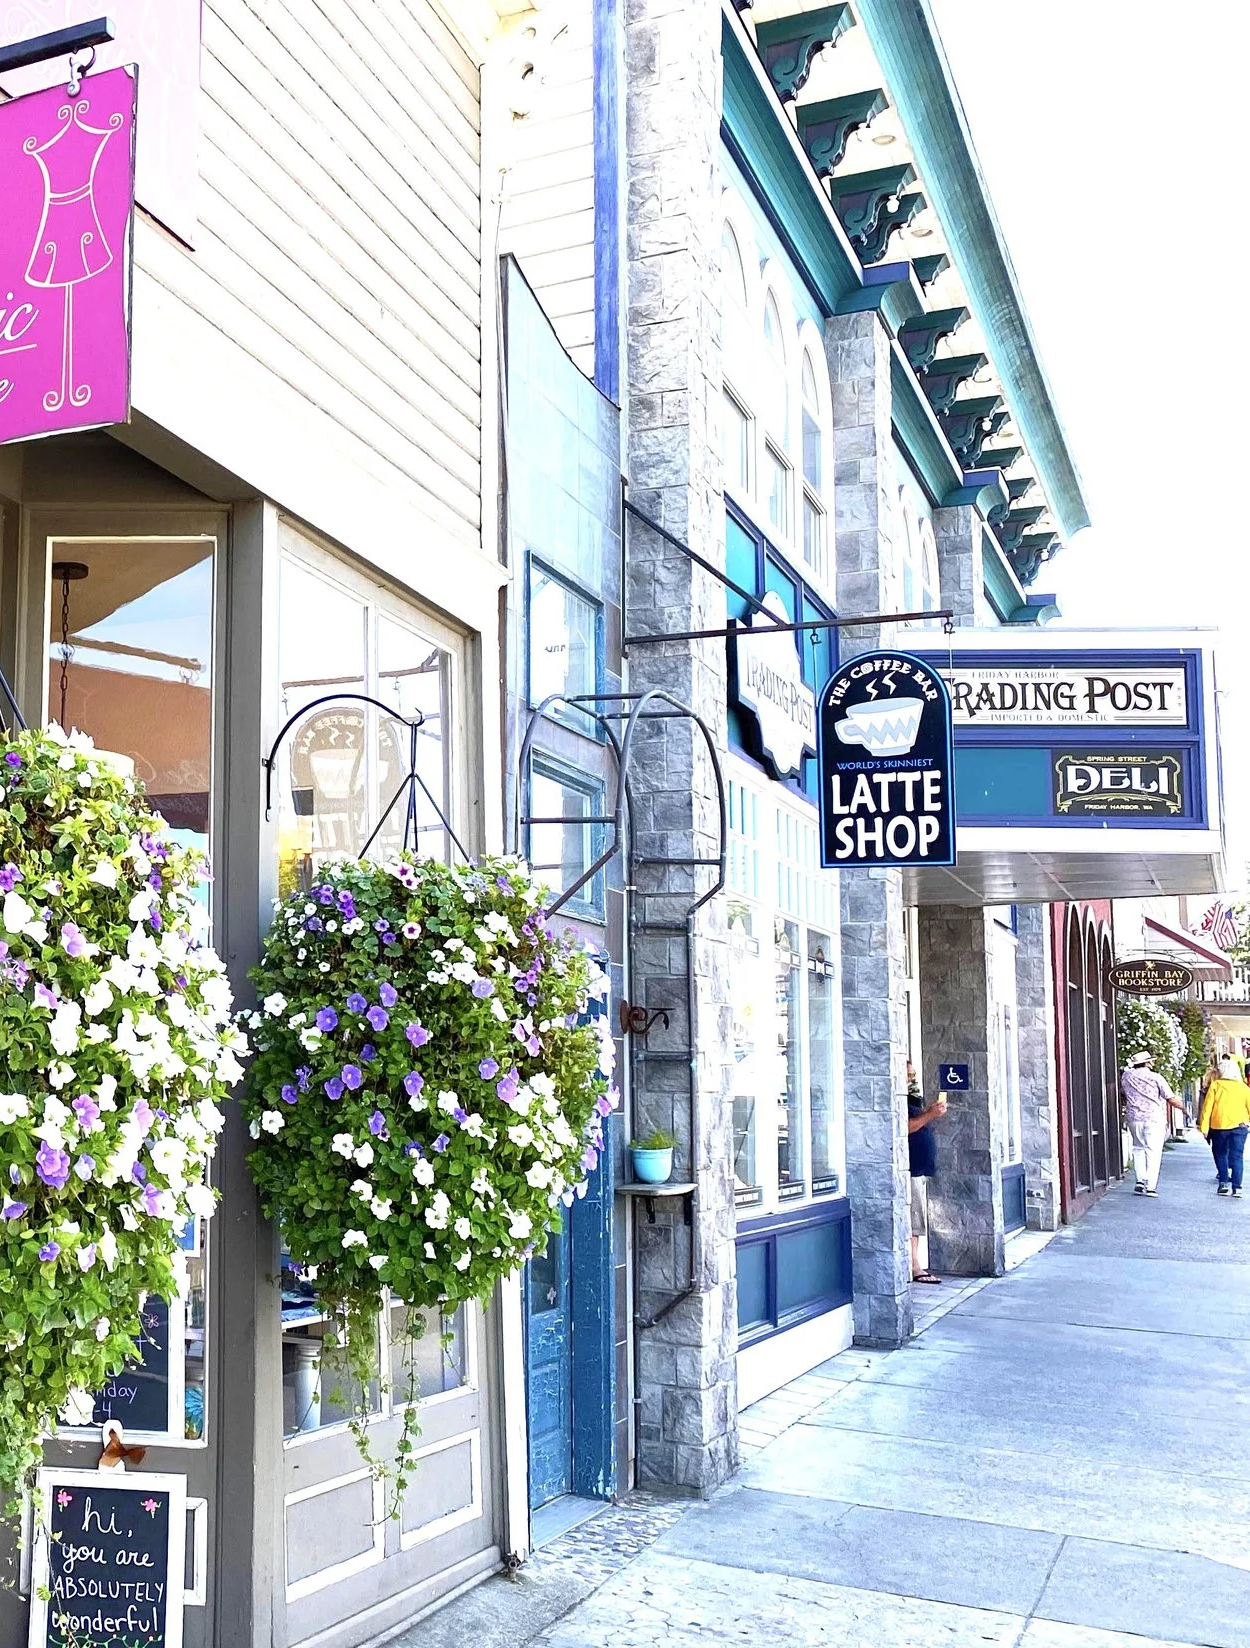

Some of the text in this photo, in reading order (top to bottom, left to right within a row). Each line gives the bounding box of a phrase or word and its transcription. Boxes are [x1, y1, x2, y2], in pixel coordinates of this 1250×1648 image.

[829, 659, 938, 707] THE COFFEE BAR
[1015, 671, 1060, 679] HARBOR
[746, 652, 813, 733] TRADING POST
[1082, 676, 1175, 714] POST
[990, 713, 1043, 722] IMPORTED
[1058, 713, 1110, 722] DOMESTIC
[837, 758, 933, 770] WORLD'S SKINNIEST
[1066, 765, 1169, 794] DELI
[831, 770, 941, 815] LATTE
[835, 815, 940, 859] SHOP
[1115, 970, 1185, 978] GRIFFIN BAY
[1118, 978, 1183, 986] BOOKSTORE
[81, 1496, 133, 1537] hi,
[62, 1543, 155, 1574] you are
[52, 1575, 164, 1603] ABSOLUTELY
[51, 1604, 158, 1635] wonderful
